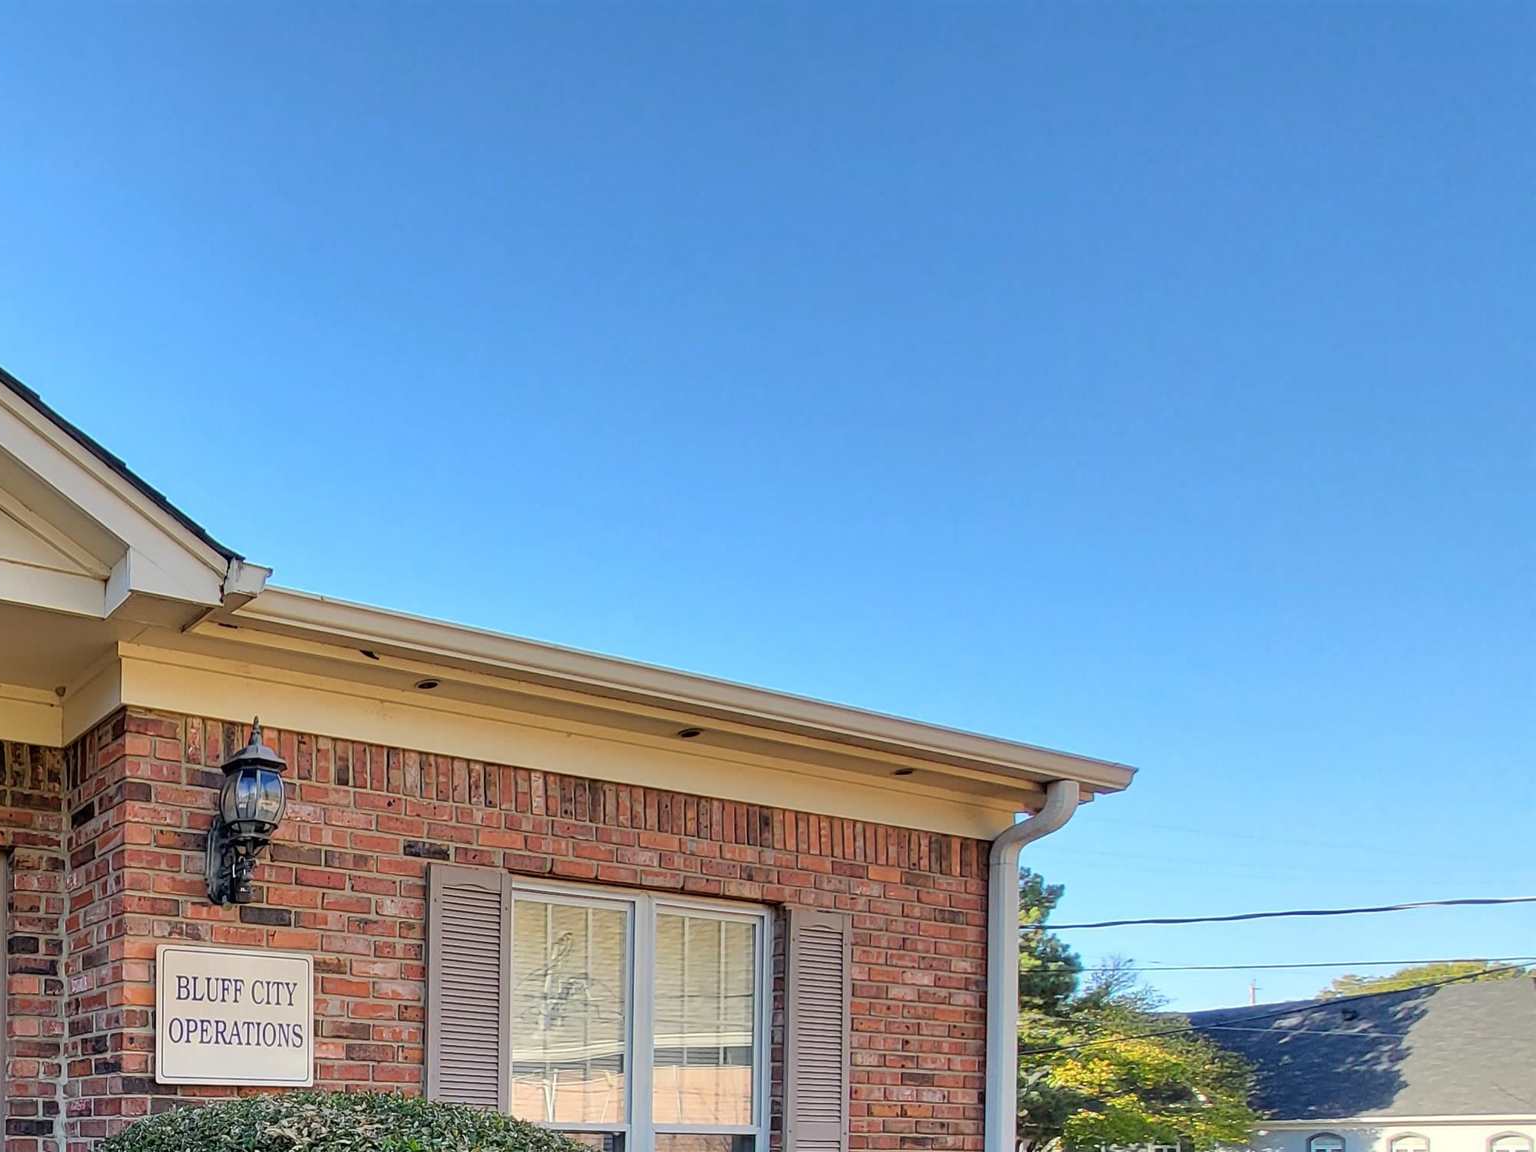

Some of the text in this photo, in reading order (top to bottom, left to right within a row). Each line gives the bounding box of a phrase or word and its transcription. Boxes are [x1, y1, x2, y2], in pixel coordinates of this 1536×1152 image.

[175, 975, 298, 1007] BLUFF CITY
[168, 1017, 304, 1049] OPERATIONS
